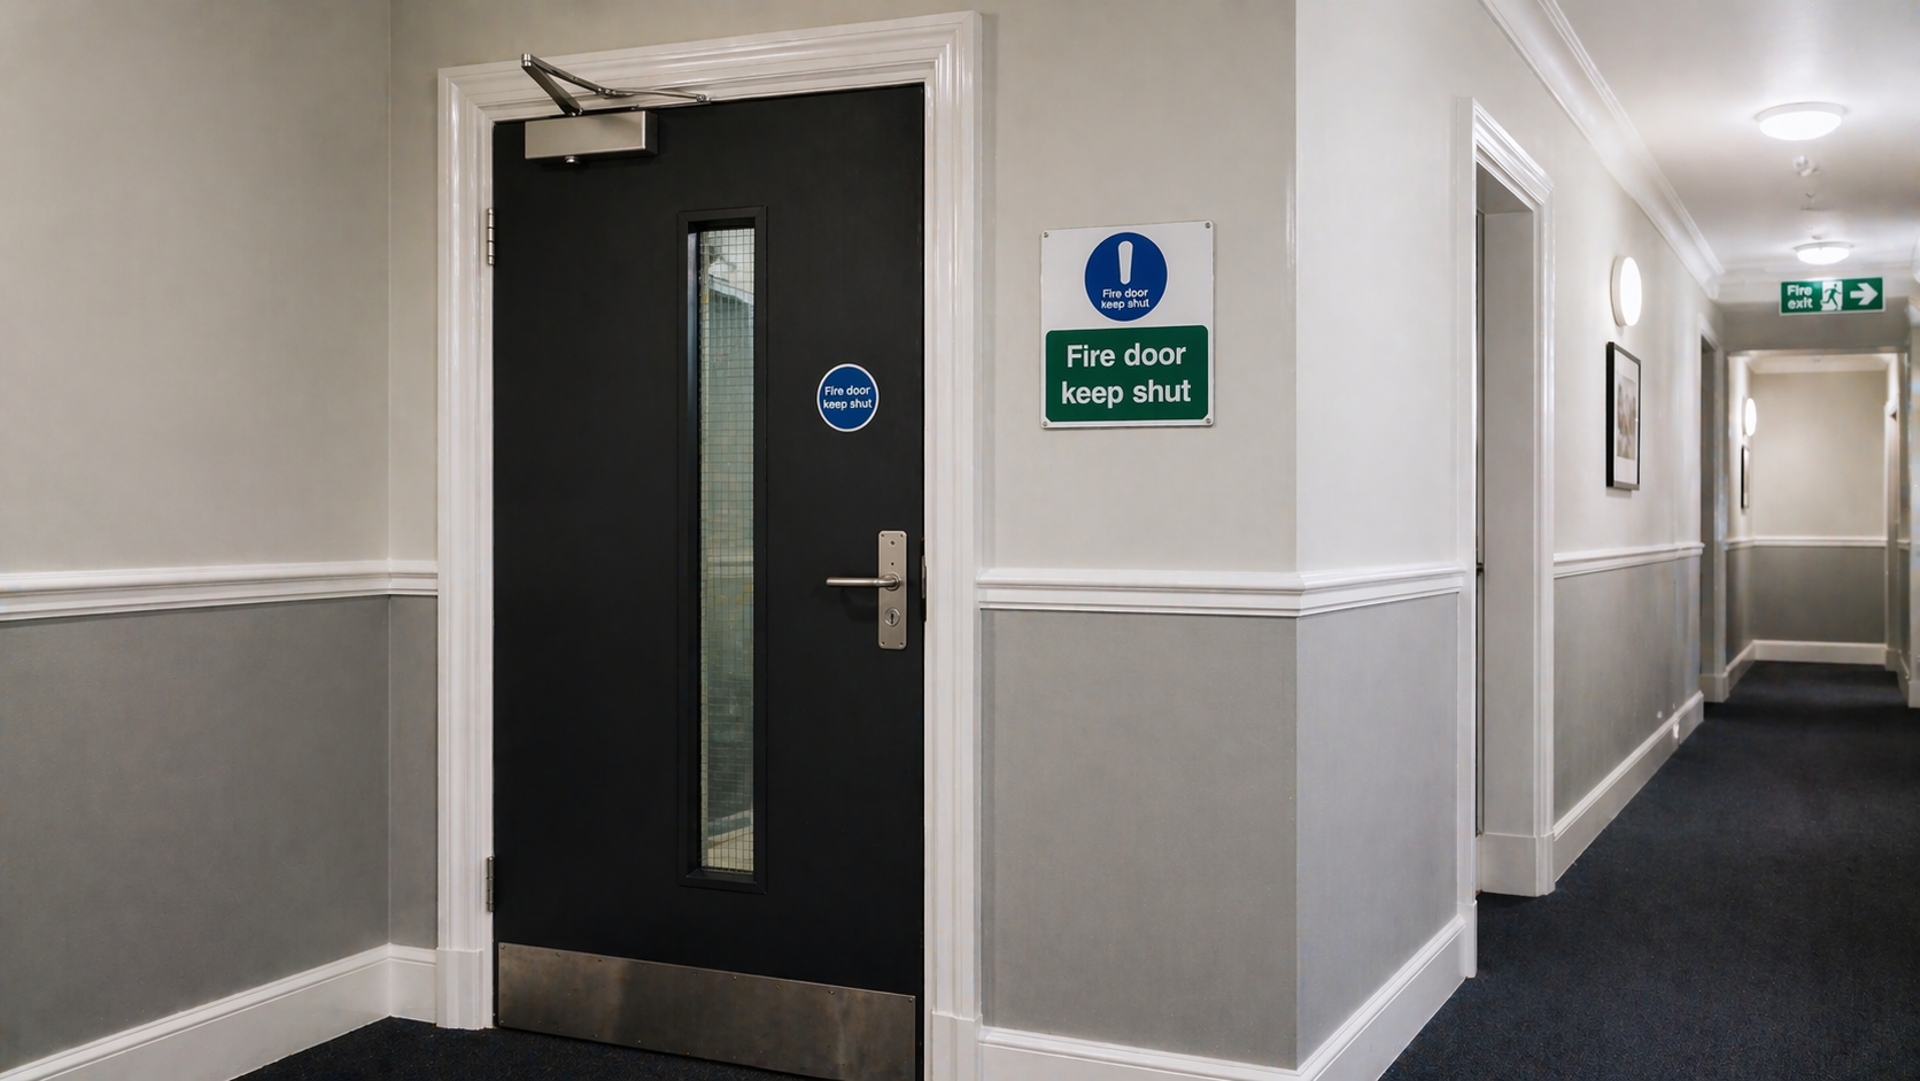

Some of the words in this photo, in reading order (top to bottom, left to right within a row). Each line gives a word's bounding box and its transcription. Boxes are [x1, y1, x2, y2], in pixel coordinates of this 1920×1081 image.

[1102, 288, 1122, 299] Fire
[1124, 288, 1149, 298] door
[1787, 284, 1813, 296] Fire
[1101, 300, 1125, 311] keep
[1127, 298, 1150, 309] shut
[1787, 297, 1813, 310] exit
[1067, 344, 1116, 368] Fire
[1124, 342, 1187, 366] door
[824, 385, 844, 396] Fire
[846, 385, 871, 396] door
[1061, 380, 1124, 409] keep
[1132, 379, 1191, 403] shut
[823, 399, 848, 411] keep
[850, 398, 873, 409] shut
